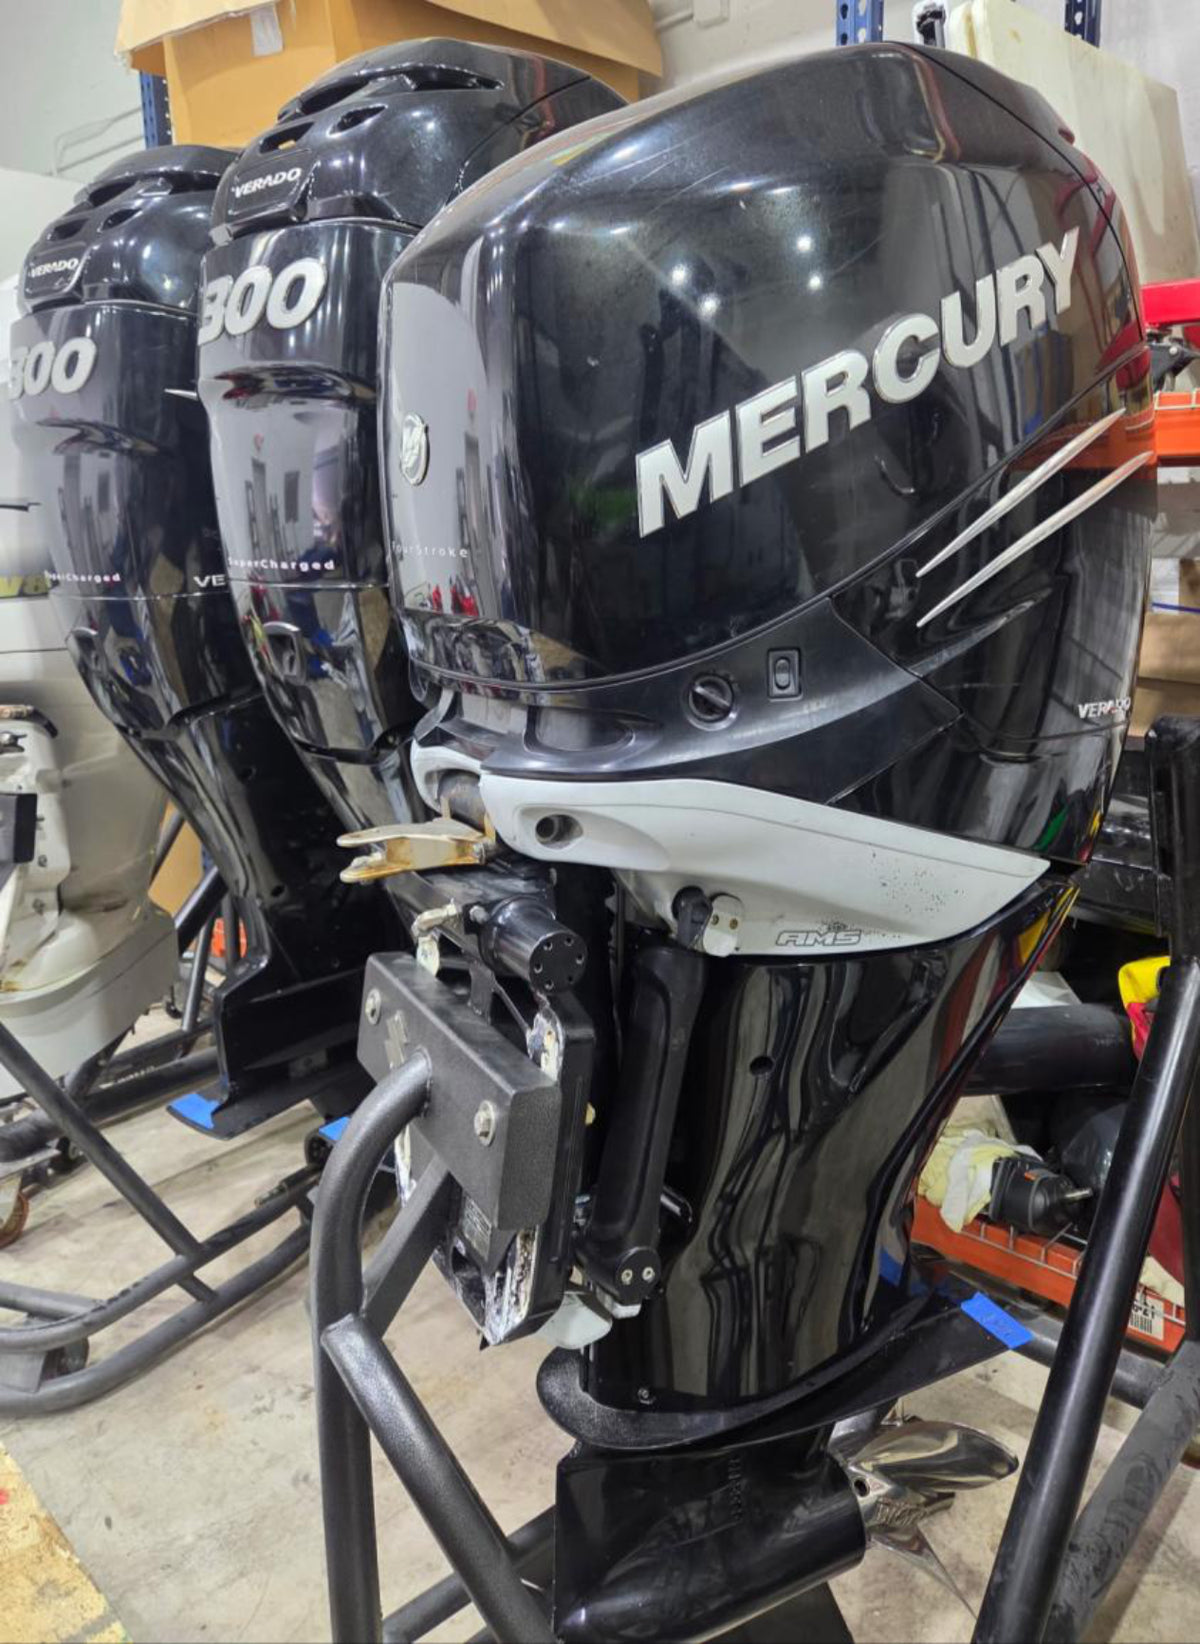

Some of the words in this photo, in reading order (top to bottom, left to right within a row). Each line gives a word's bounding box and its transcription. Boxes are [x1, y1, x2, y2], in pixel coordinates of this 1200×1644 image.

[233, 167, 302, 198] VERADO
[30, 257, 79, 278] VERADO
[635, 226, 1080, 539] MERCURY
[775, 929, 862, 946] AMS
